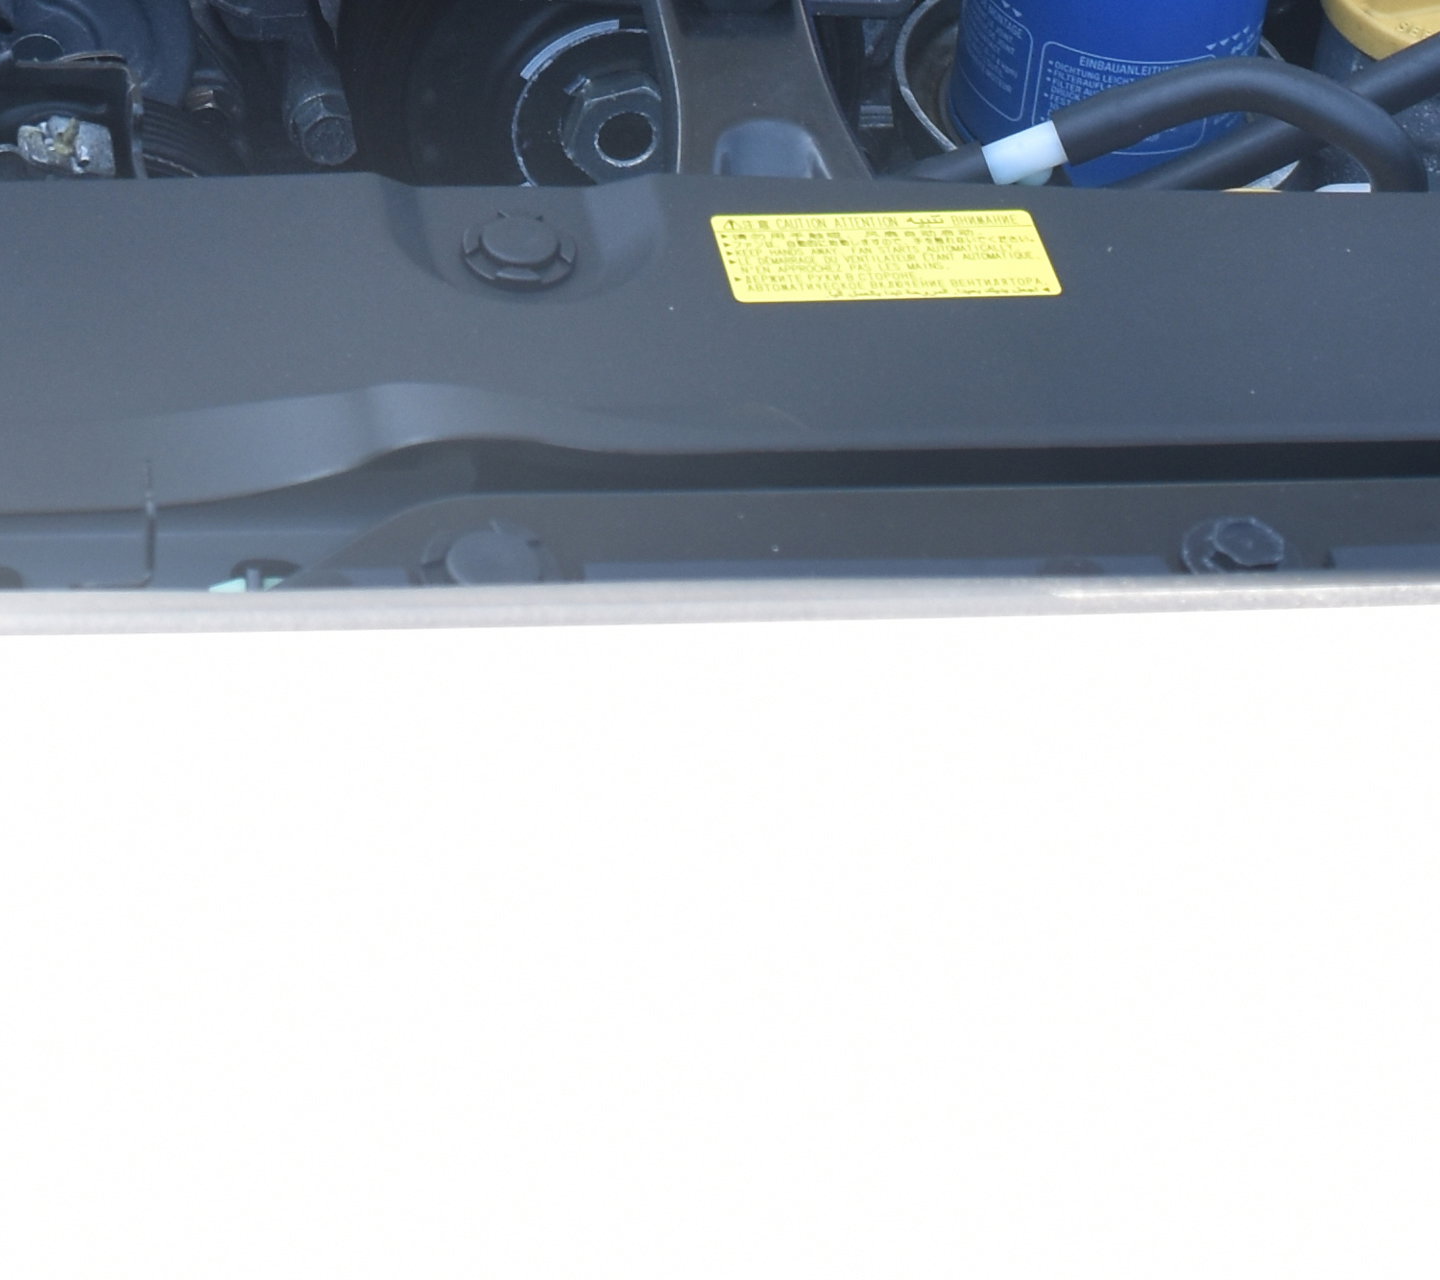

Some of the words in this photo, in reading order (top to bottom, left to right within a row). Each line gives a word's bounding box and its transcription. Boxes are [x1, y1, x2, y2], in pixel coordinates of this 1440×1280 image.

[1054, 60, 1100, 81] DICHTUNG
[1052, 78, 1083, 95] FILTER
[776, 217, 826, 229] CAUTION
[834, 216, 898, 228] ATTENTION
[951, 214, 1017, 226] ВНИМАНИЕ
